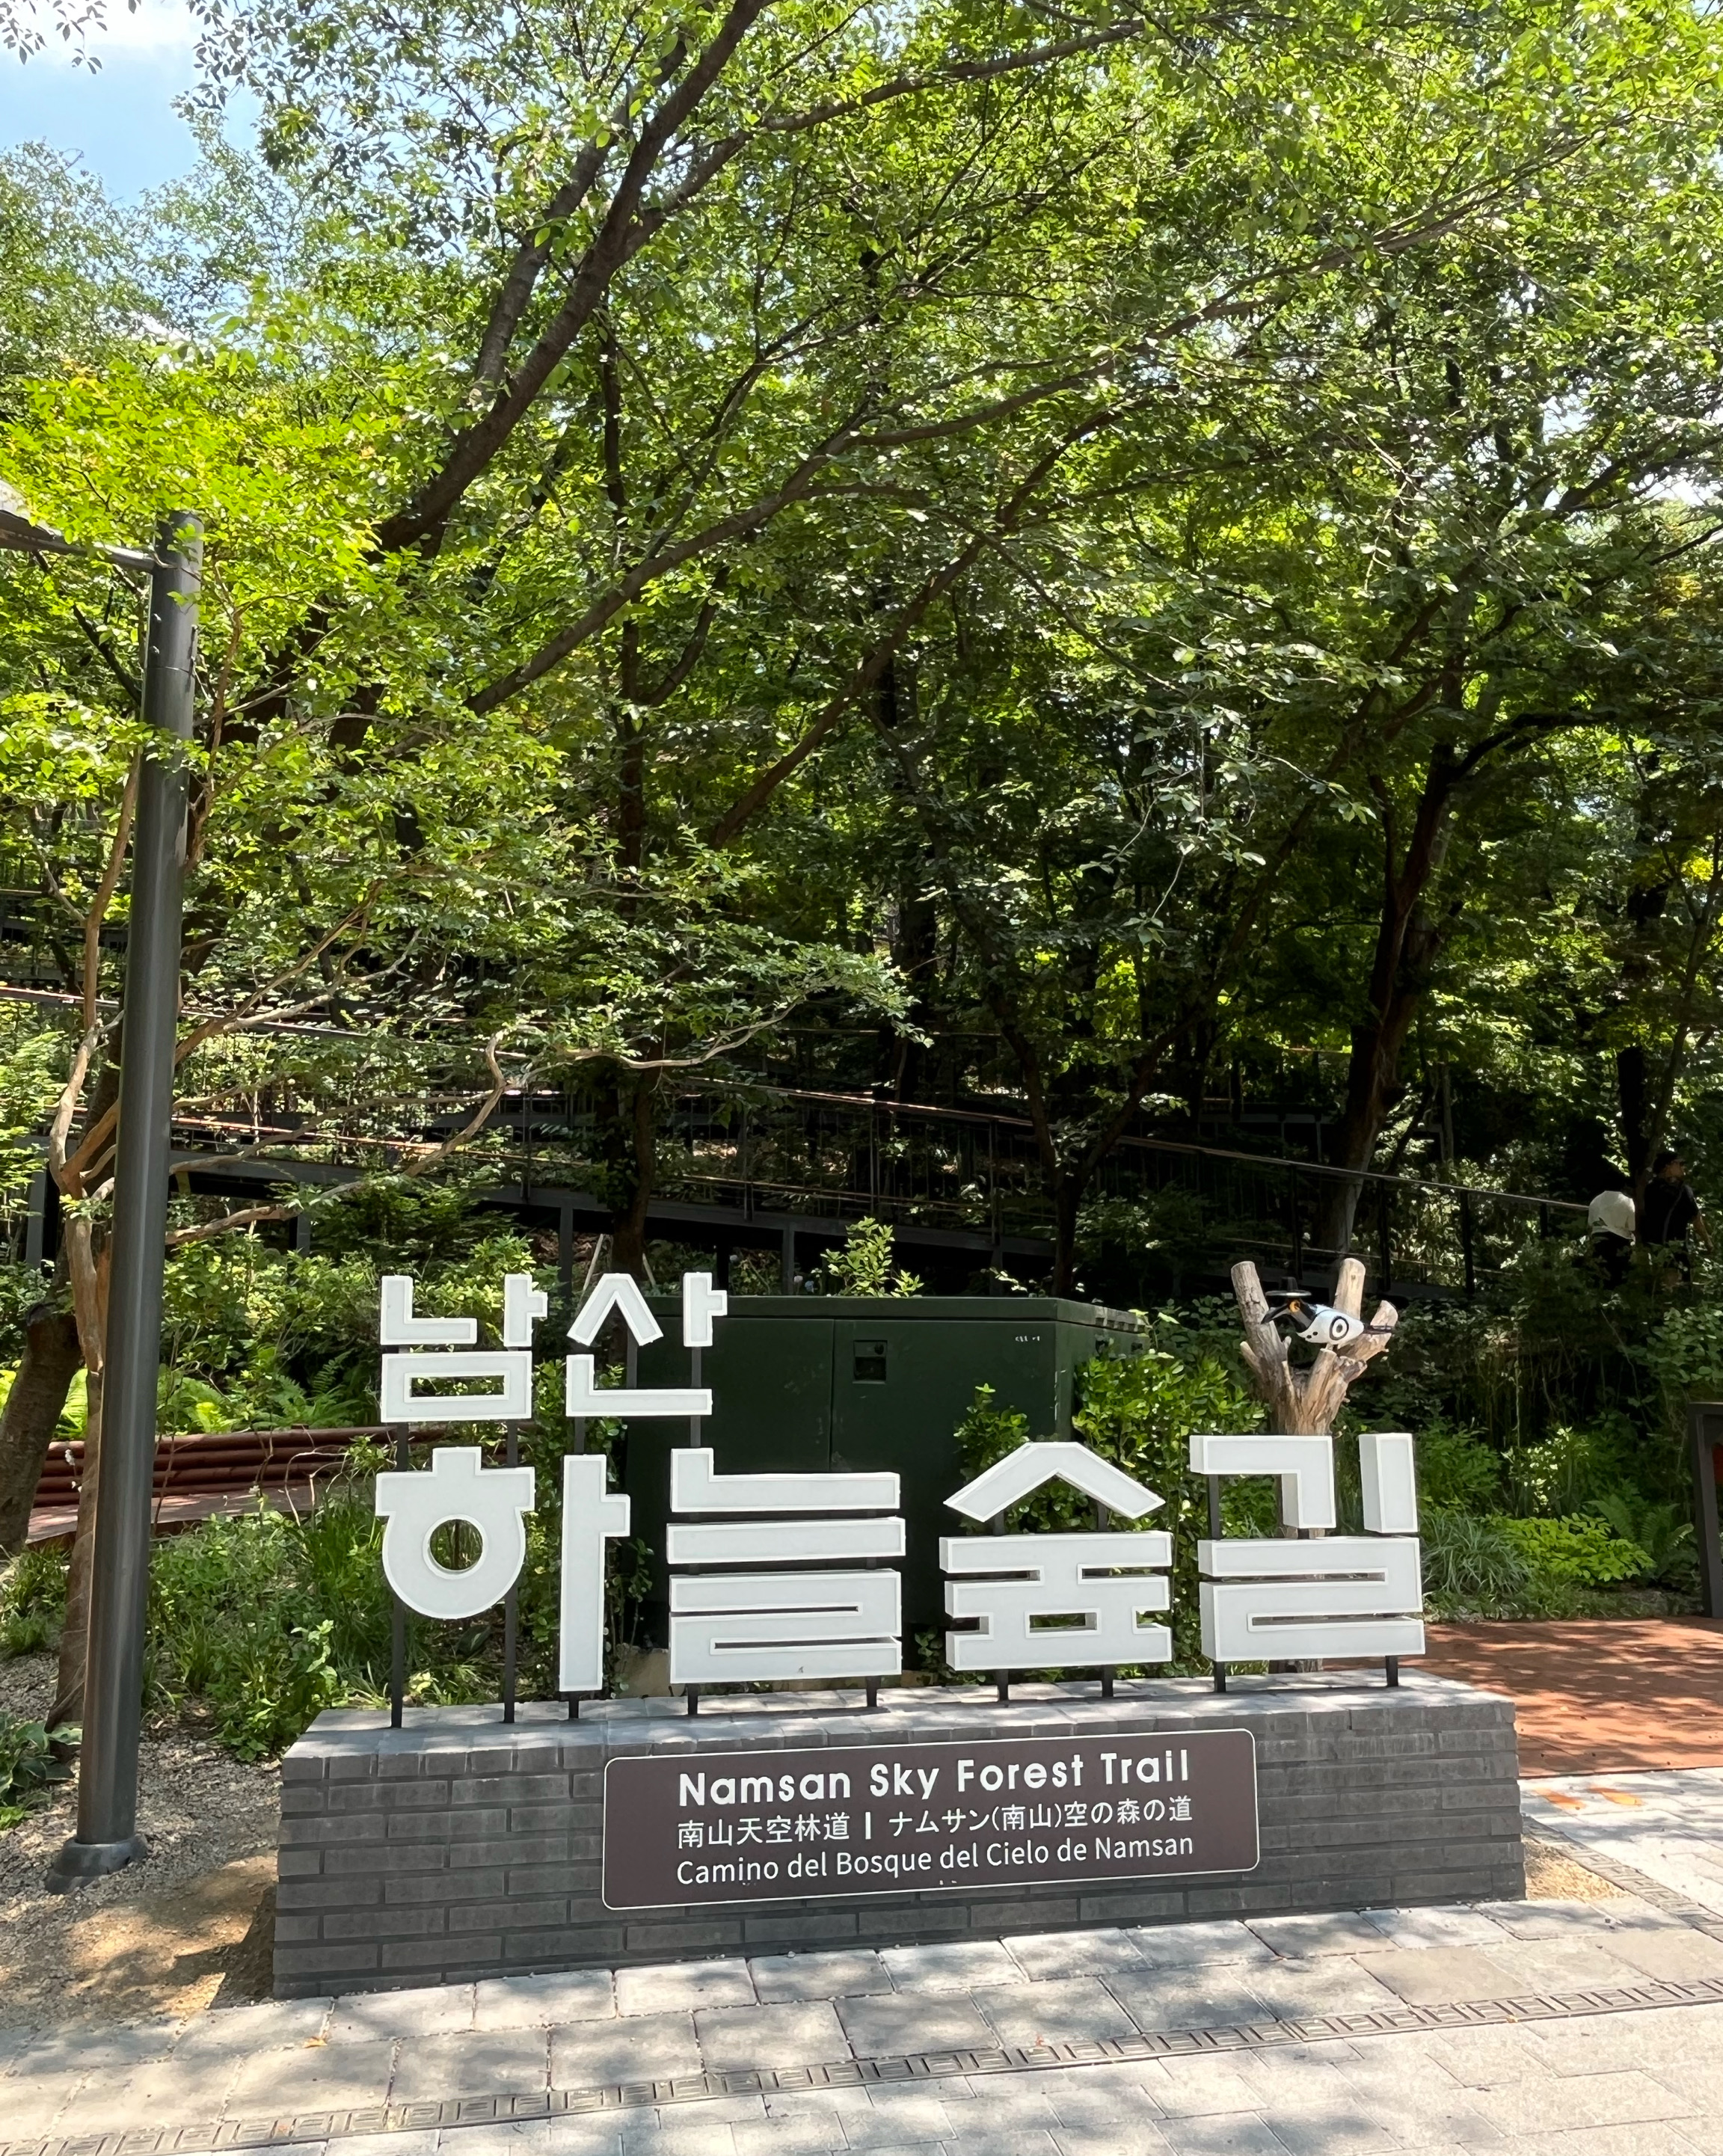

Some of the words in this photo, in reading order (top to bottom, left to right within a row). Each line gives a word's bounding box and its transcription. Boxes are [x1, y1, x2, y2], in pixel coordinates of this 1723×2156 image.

[380, 1272, 727, 1422] 남산
[375, 1433, 1425, 1692] 하늘숲길
[678, 1772, 851, 1807] Namsan
[870, 1763, 940, 1800] Sky
[957, 1754, 1084, 1793] Forest
[1100, 1749, 1188, 1785] Trail
[678, 1811, 850, 1849] 南山天空林道
[888, 1795, 1193, 1837] ナムサン(南山)空の森の道
[677, 1857, 779, 1885] Camino
[787, 1852, 828, 1879] del
[837, 1851, 932, 1879] Bosque
[939, 1843, 978, 1869] del
[986, 1837, 1049, 1867] Cielo
[1056, 1837, 1087, 1862] de
[1096, 1835, 1194, 1861] Namsan
